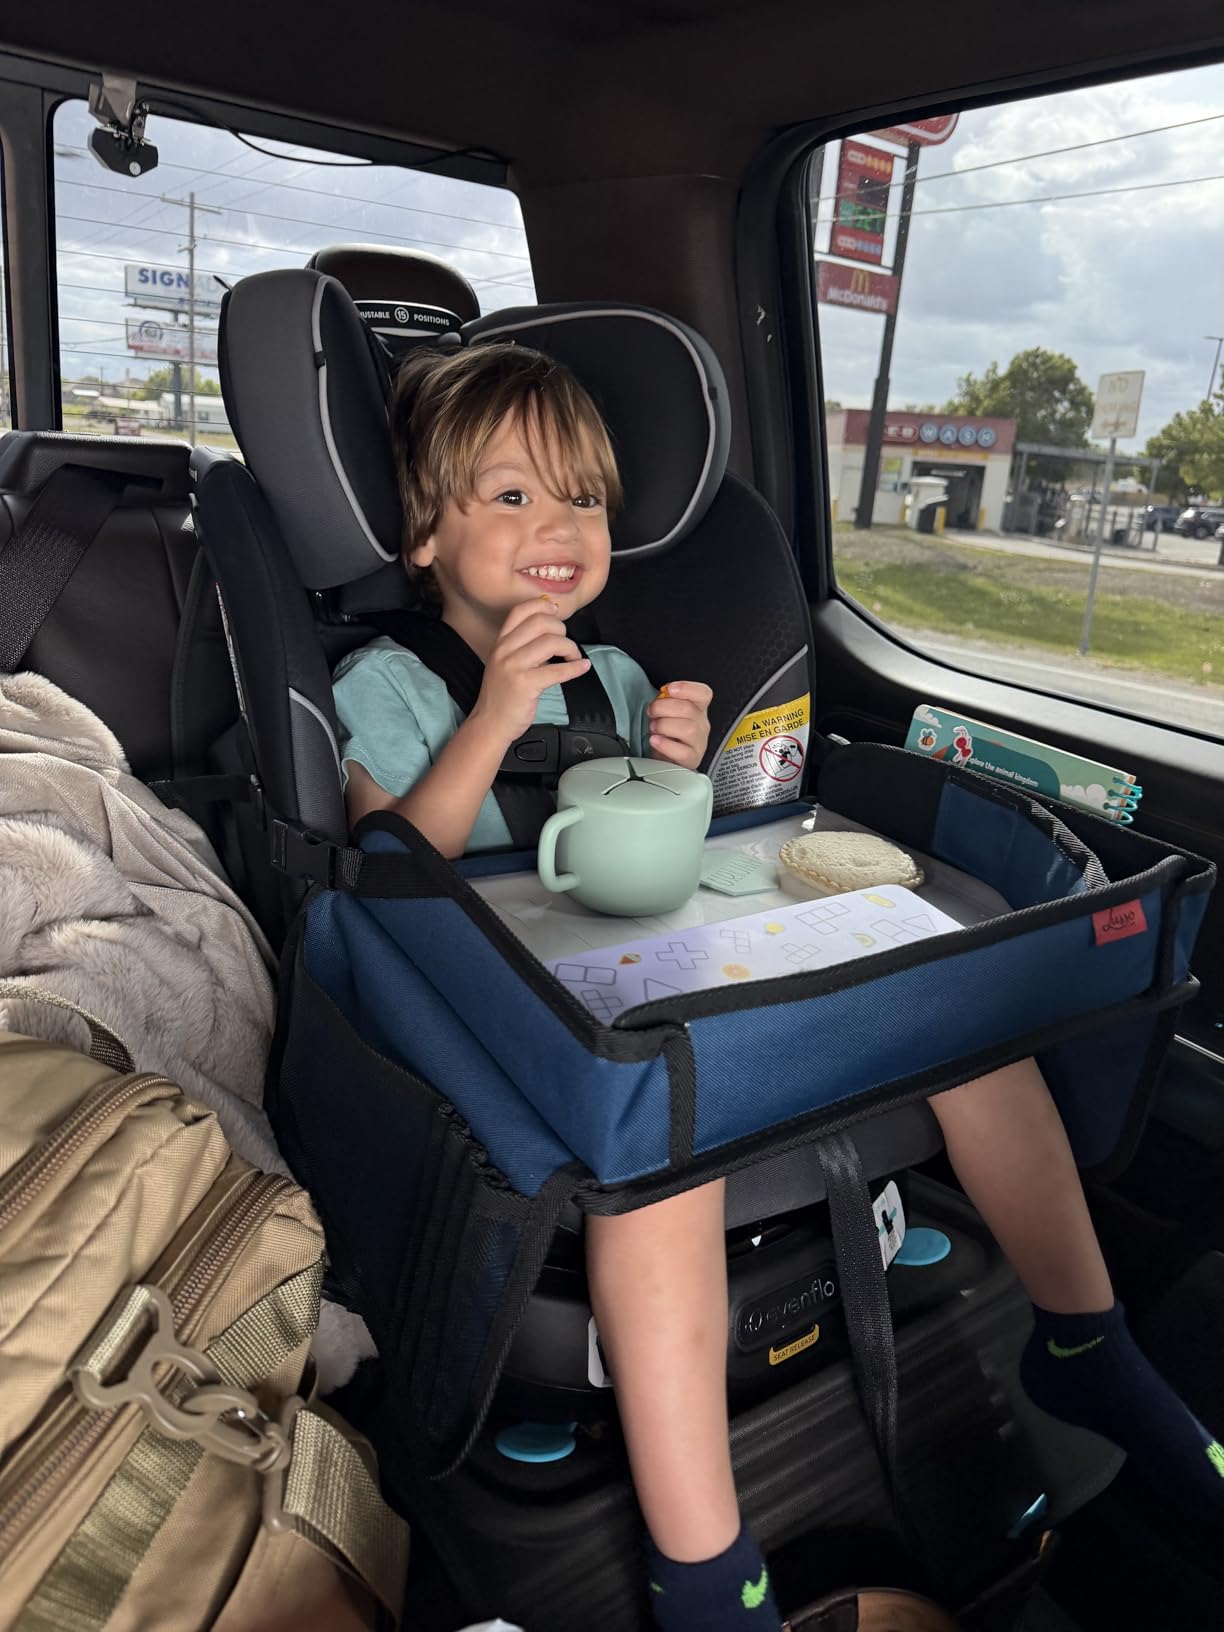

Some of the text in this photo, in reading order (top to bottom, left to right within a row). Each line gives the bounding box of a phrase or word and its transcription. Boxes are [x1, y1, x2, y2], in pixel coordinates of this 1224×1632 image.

[827, 286, 889, 309] McDonald's
[360, 309, 450, 326] JUSTABLE 15 POSITIONS
[922, 424, 993, 445] WASH
[761, 708, 804, 727] WARNING
[736, 717, 805, 745] MISE EN GARDE
[984, 761, 995, 771] the
[766, 1278, 835, 1321] evenflo
[773, 1335, 816, 1361] SEAT RELEASE
